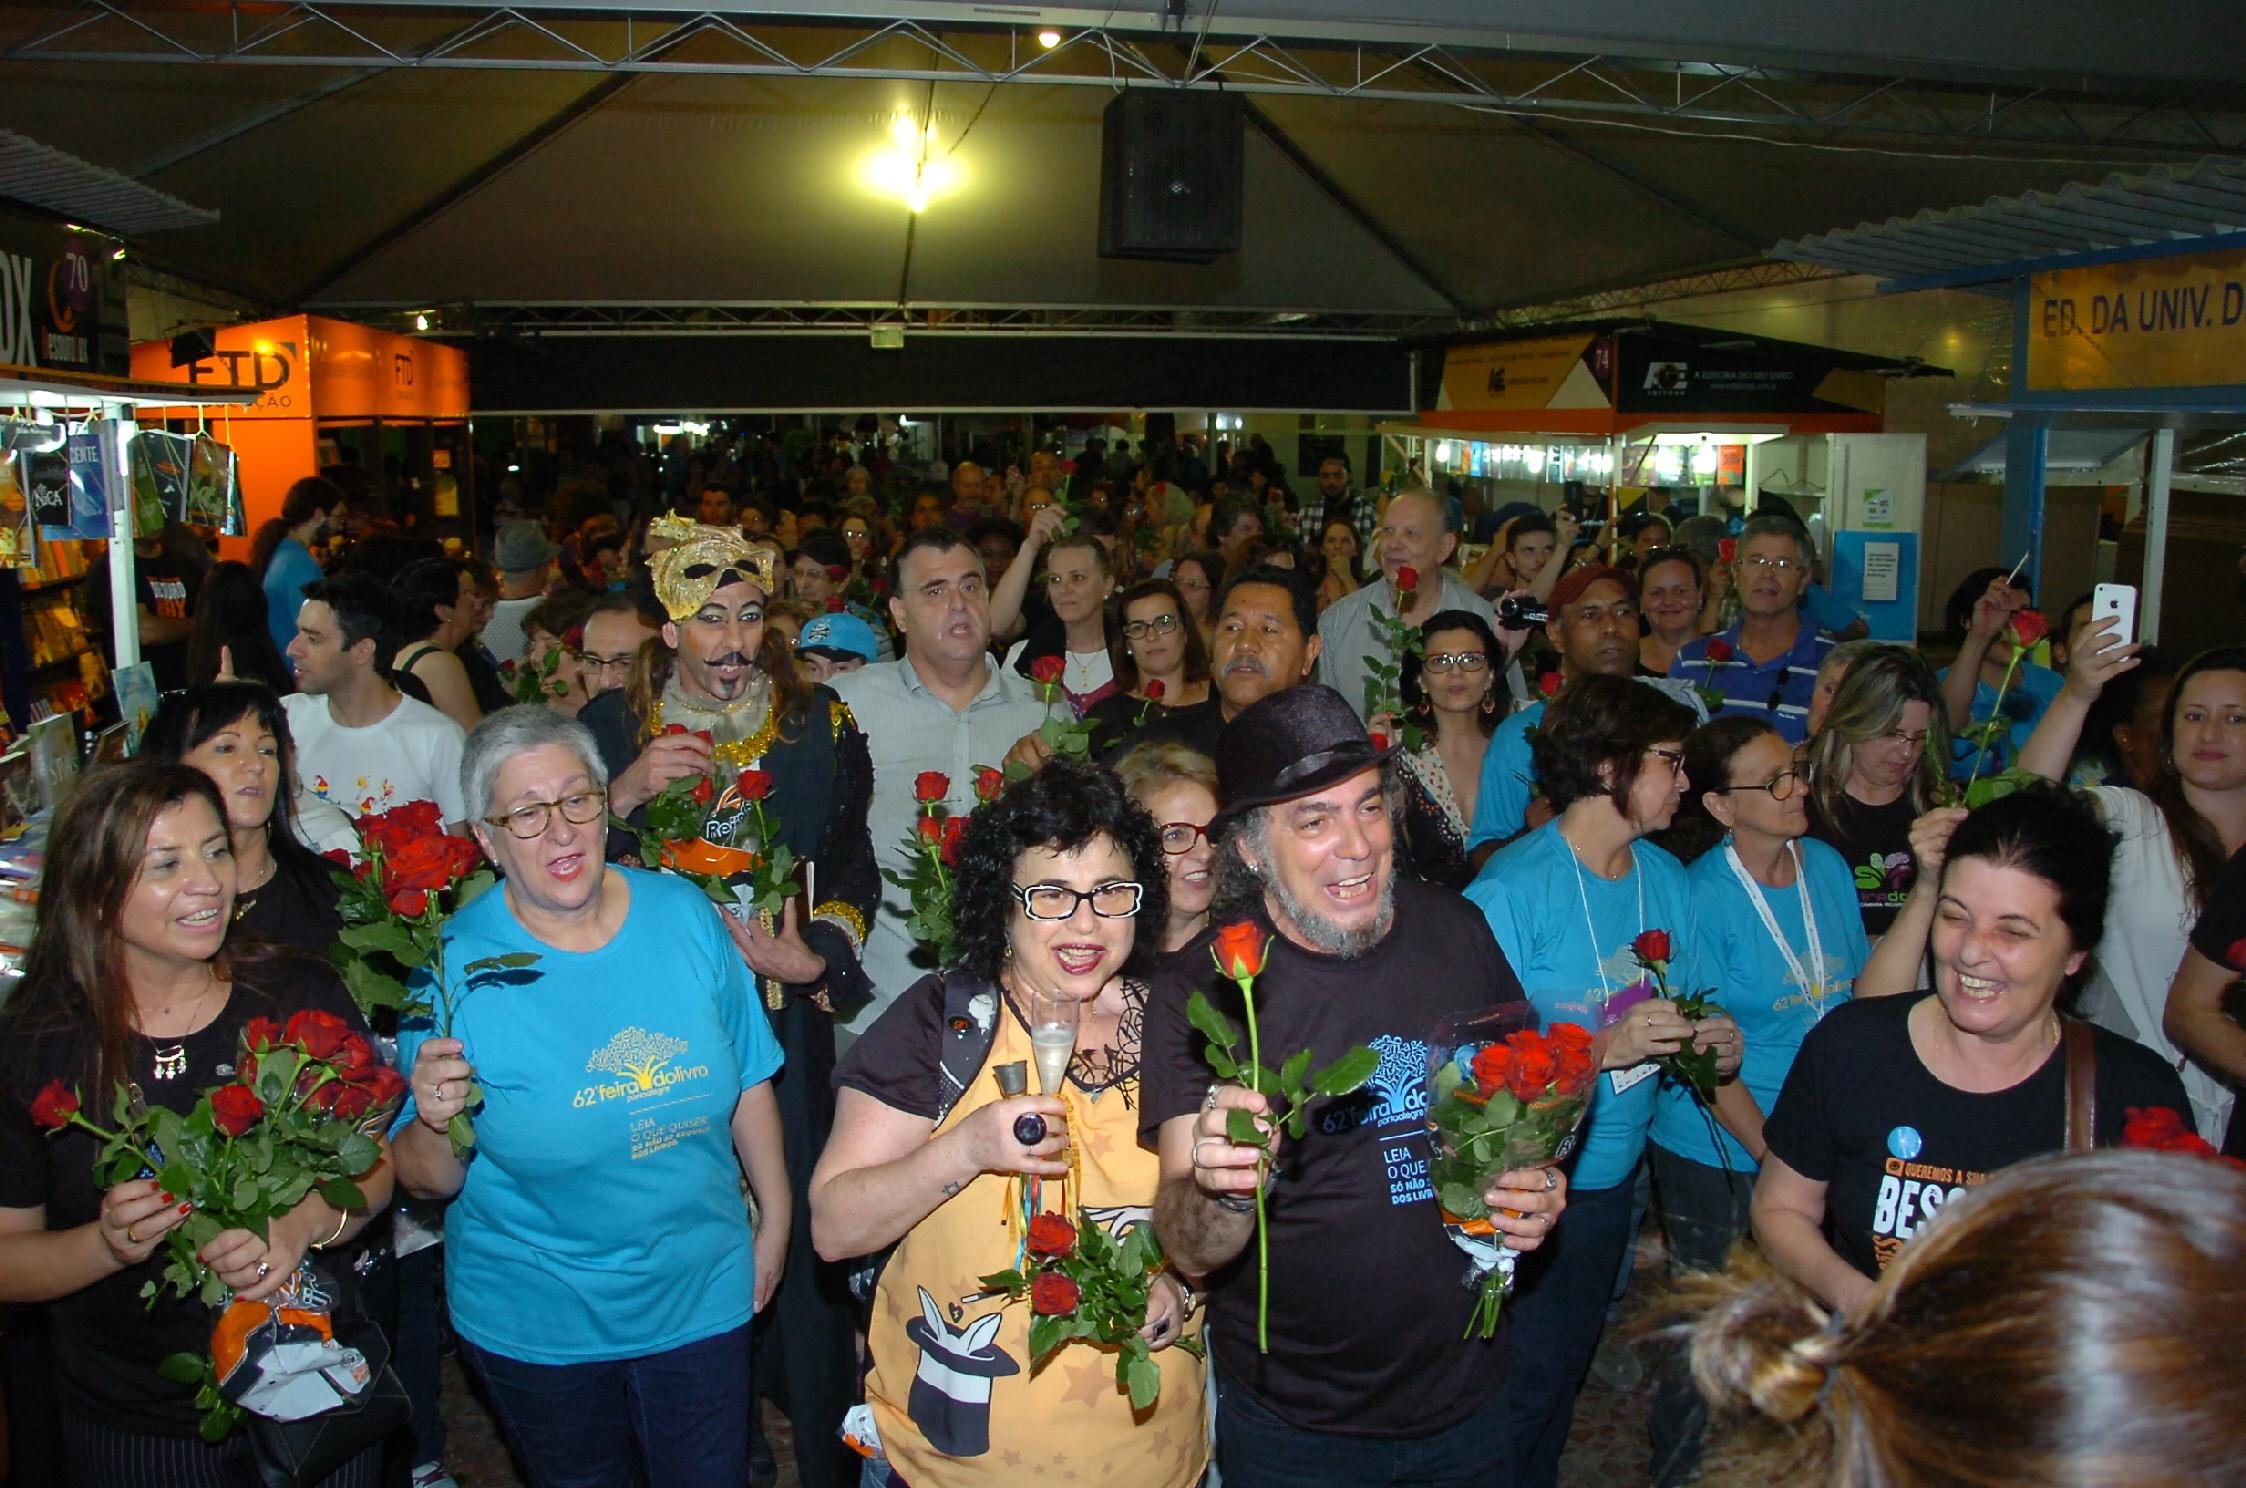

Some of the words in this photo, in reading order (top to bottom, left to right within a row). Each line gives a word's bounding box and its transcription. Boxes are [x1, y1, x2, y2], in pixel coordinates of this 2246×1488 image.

[66, 252, 89, 292] 70
[2092, 292, 2129, 335] DA
[2139, 283, 2212, 333] UNIV.
[395, 352, 414, 386] FTD
[1596, 349, 1609, 369] 74
[188, 350, 291, 391] FTD
[599, 1080, 640, 1101] feira
[629, 1117, 655, 1131] LEIA
[1377, 1108, 1425, 1127] portoalegre
[631, 1132, 640, 1142] O
[643, 1124, 666, 1139] QUE
[1383, 1147, 1412, 1163] LEIA
[1387, 1165, 1399, 1179] O
[1400, 1159, 1427, 1178] QUE
[1905, 1162, 1953, 1183] QUEREMOS
[1955, 1169, 1963, 1184] A
[1390, 1180, 1404, 1193] SÓ
[1405, 1177, 1425, 1190] NÃO
[1391, 1193, 1412, 1205] DOS
[1873, 1174, 1968, 1240] BES
